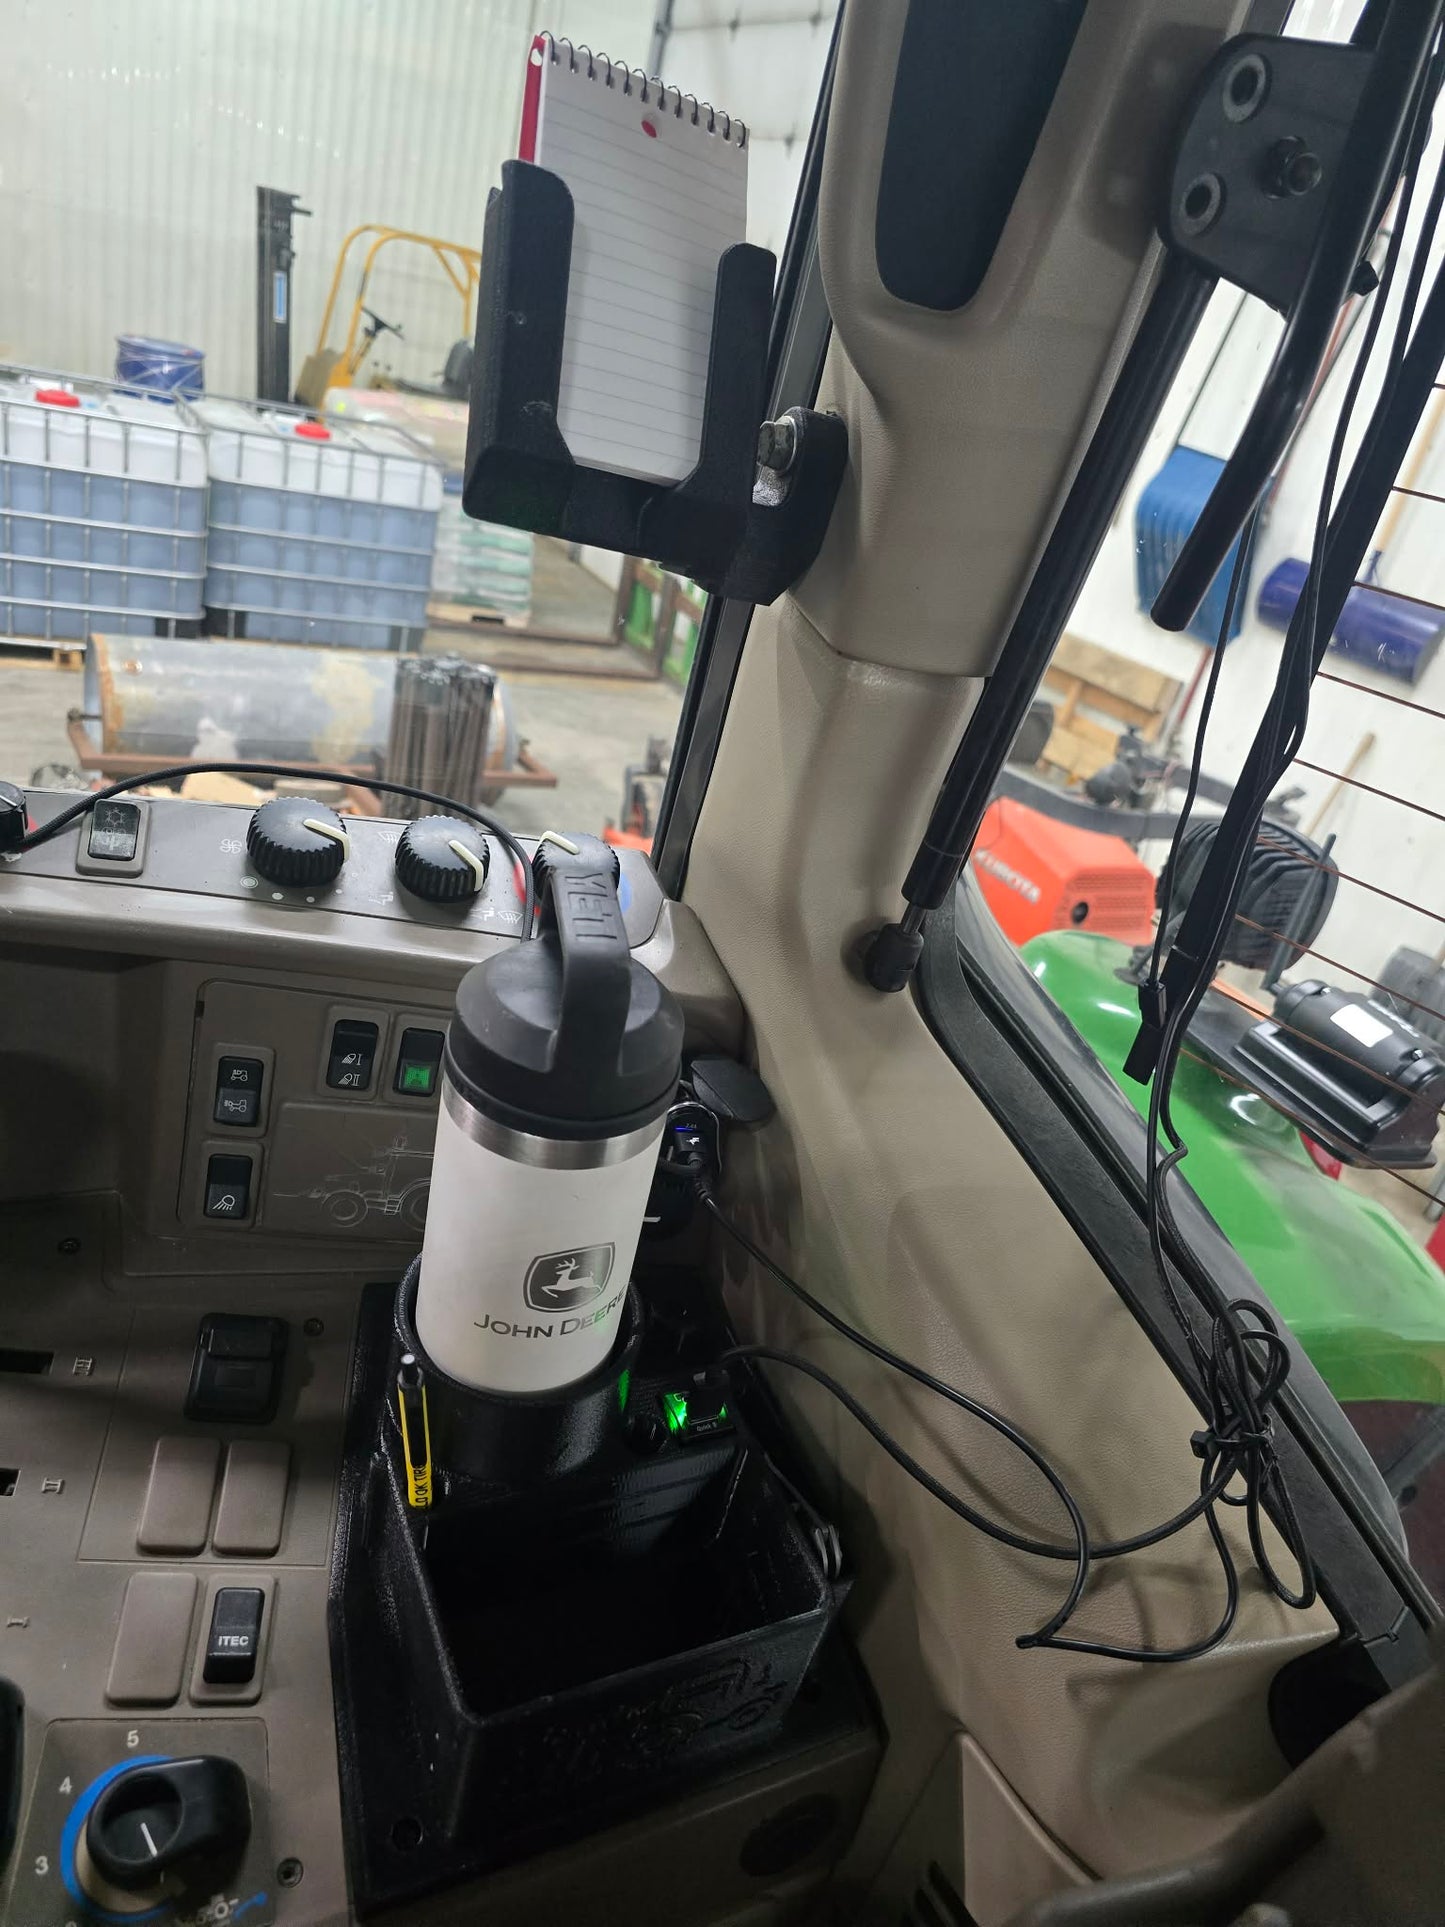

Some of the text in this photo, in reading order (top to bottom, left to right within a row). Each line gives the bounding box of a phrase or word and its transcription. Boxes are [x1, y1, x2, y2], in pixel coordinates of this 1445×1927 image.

[564, 872, 618, 940] YETI
[474, 1314, 553, 1339] JOHN
[218, 1635, 249, 1647] ITEC
[127, 1730, 139, 1748] 5
[59, 1777, 72, 1794] 4
[35, 1856, 49, 1875] 3
